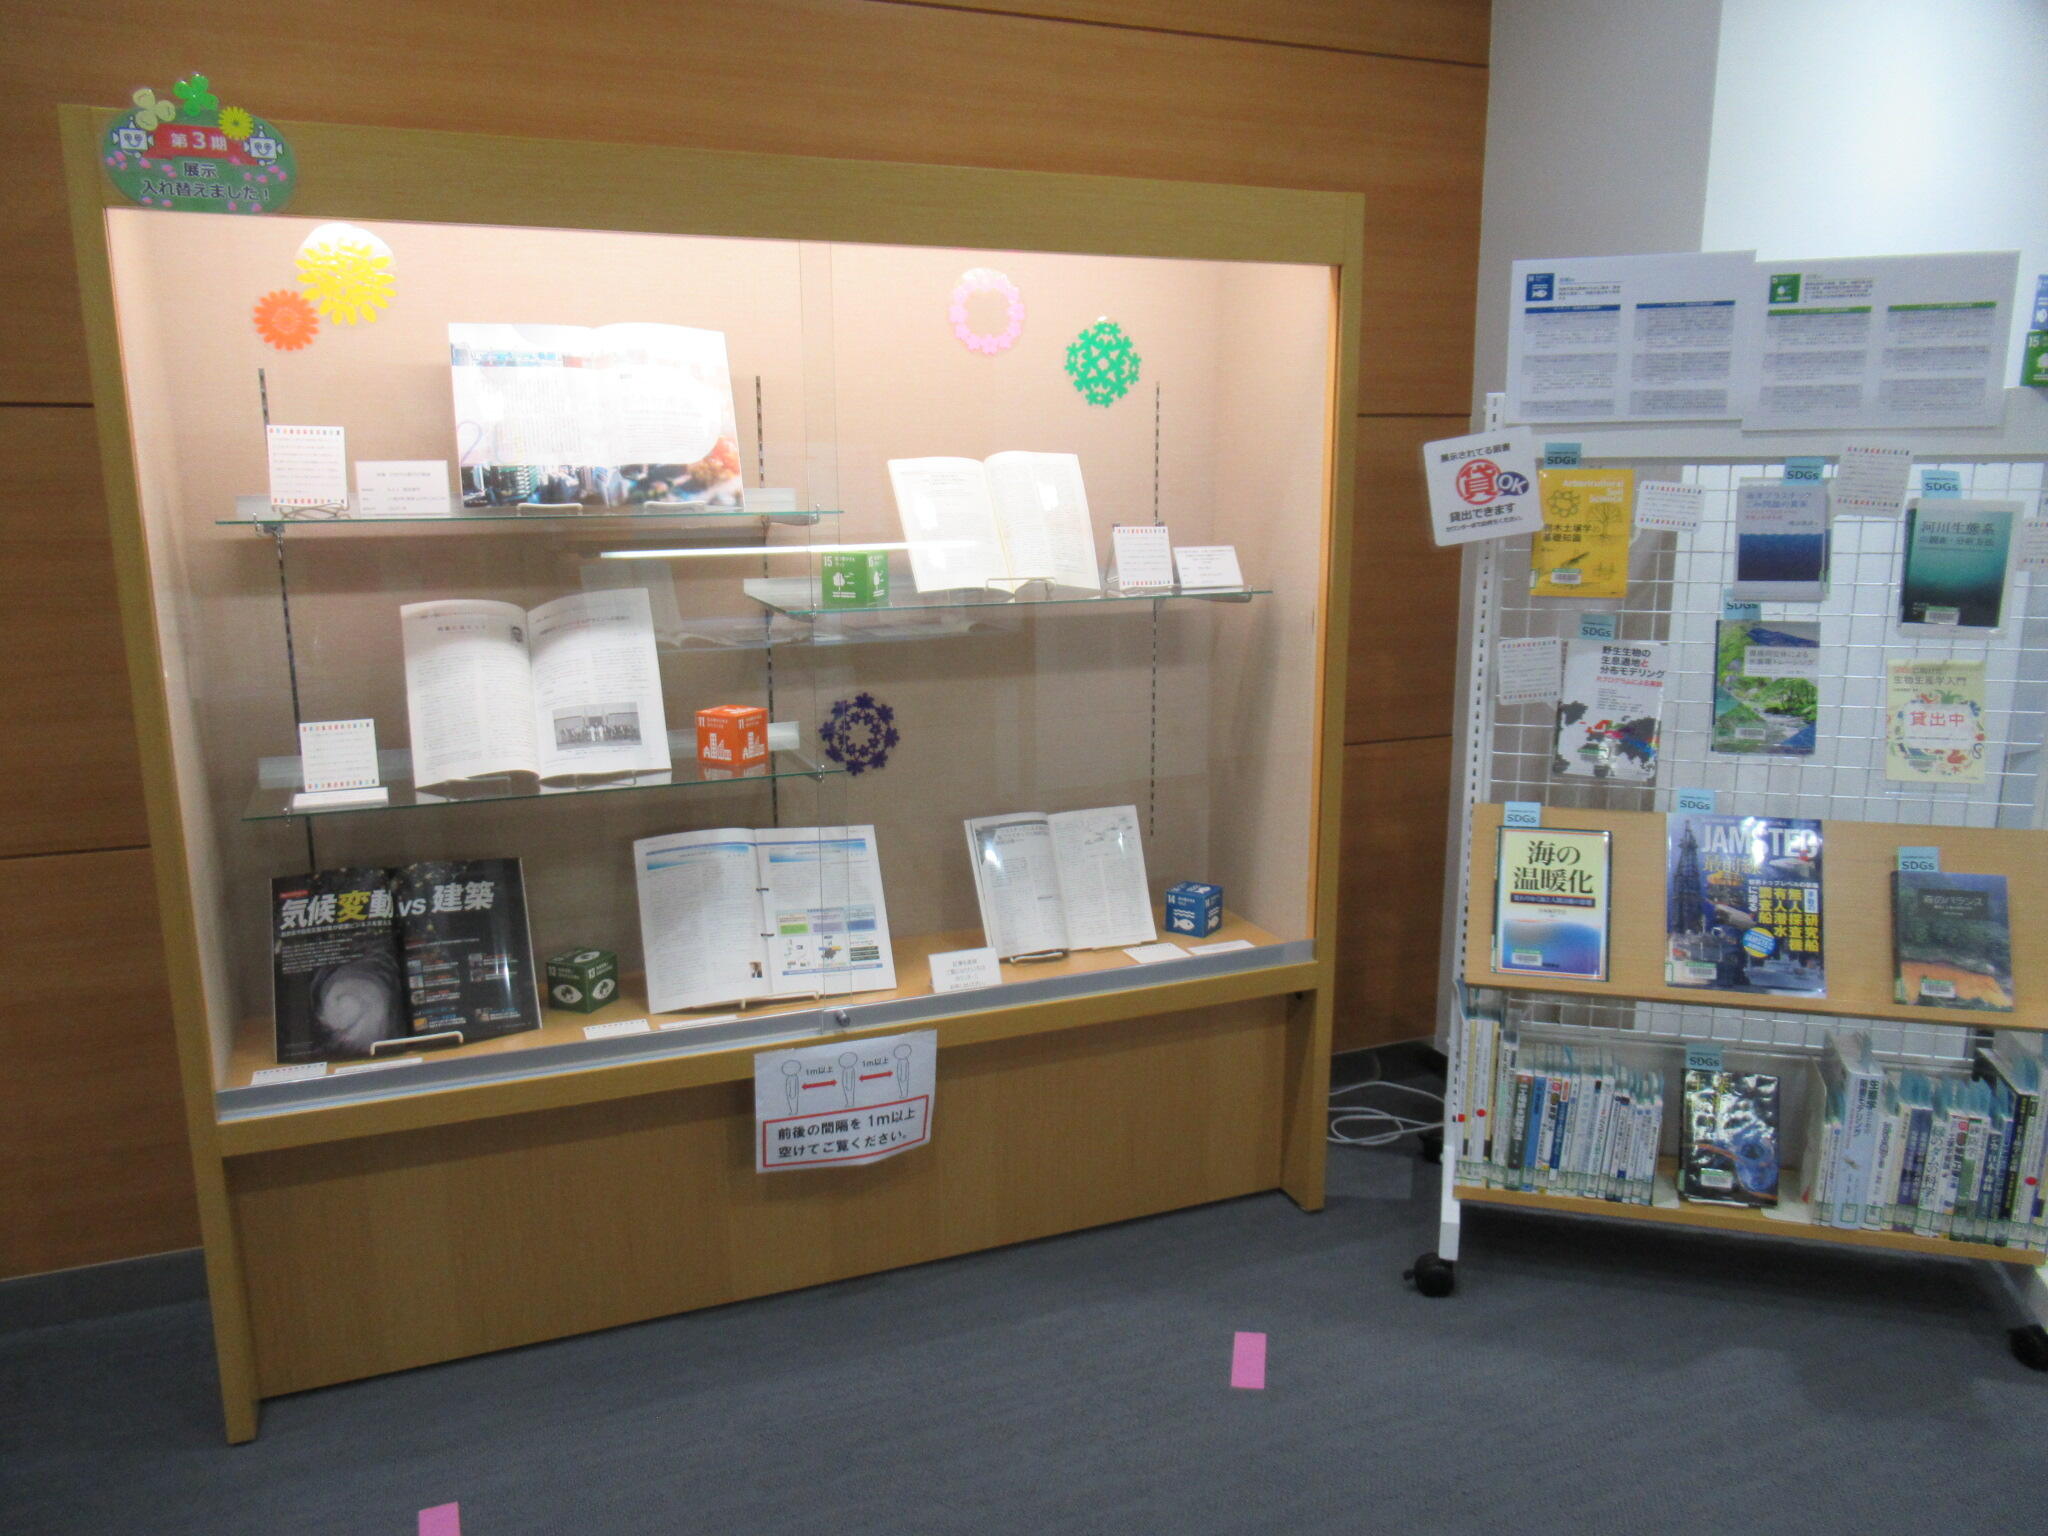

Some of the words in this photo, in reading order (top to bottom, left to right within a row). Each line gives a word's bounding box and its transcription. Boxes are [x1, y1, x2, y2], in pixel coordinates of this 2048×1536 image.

[183, 160, 217, 179] 展示
[1546, 456, 1577, 465] SDGs
[1787, 471, 1820, 480] SDGs
[1498, 474, 1527, 495] OK
[1925, 482, 1958, 491] SDGs
[1449, 502, 1516, 522] 貸出できます
[1582, 627, 1611, 637] SDGs
[1602, 646, 1651, 657] 野生生物の
[1600, 666, 1665, 679] 分布モデリング
[1909, 711, 1964, 727] 貸出中
[1680, 800, 1711, 810] SDGs
[1507, 814, 1537, 824] SDGs
[1528, 840, 1581, 866] 海の
[1901, 861, 1934, 871] SDGs
[1513, 866, 1594, 894] 温暖化
[280, 888, 394, 931] 気候変動
[398, 897, 427, 918] vs
[431, 881, 496, 914] 建築
[862, 1057, 889, 1068] 1m以上
[1689, 1056, 1720, 1067] SDGs
[805, 1065, 835, 1076] 1m以上
[777, 1117, 861, 1140] 前後の間隔を
[868, 1107, 916, 1129] 1m以上
[777, 1130, 909, 1158] 空けてご覧ください。
